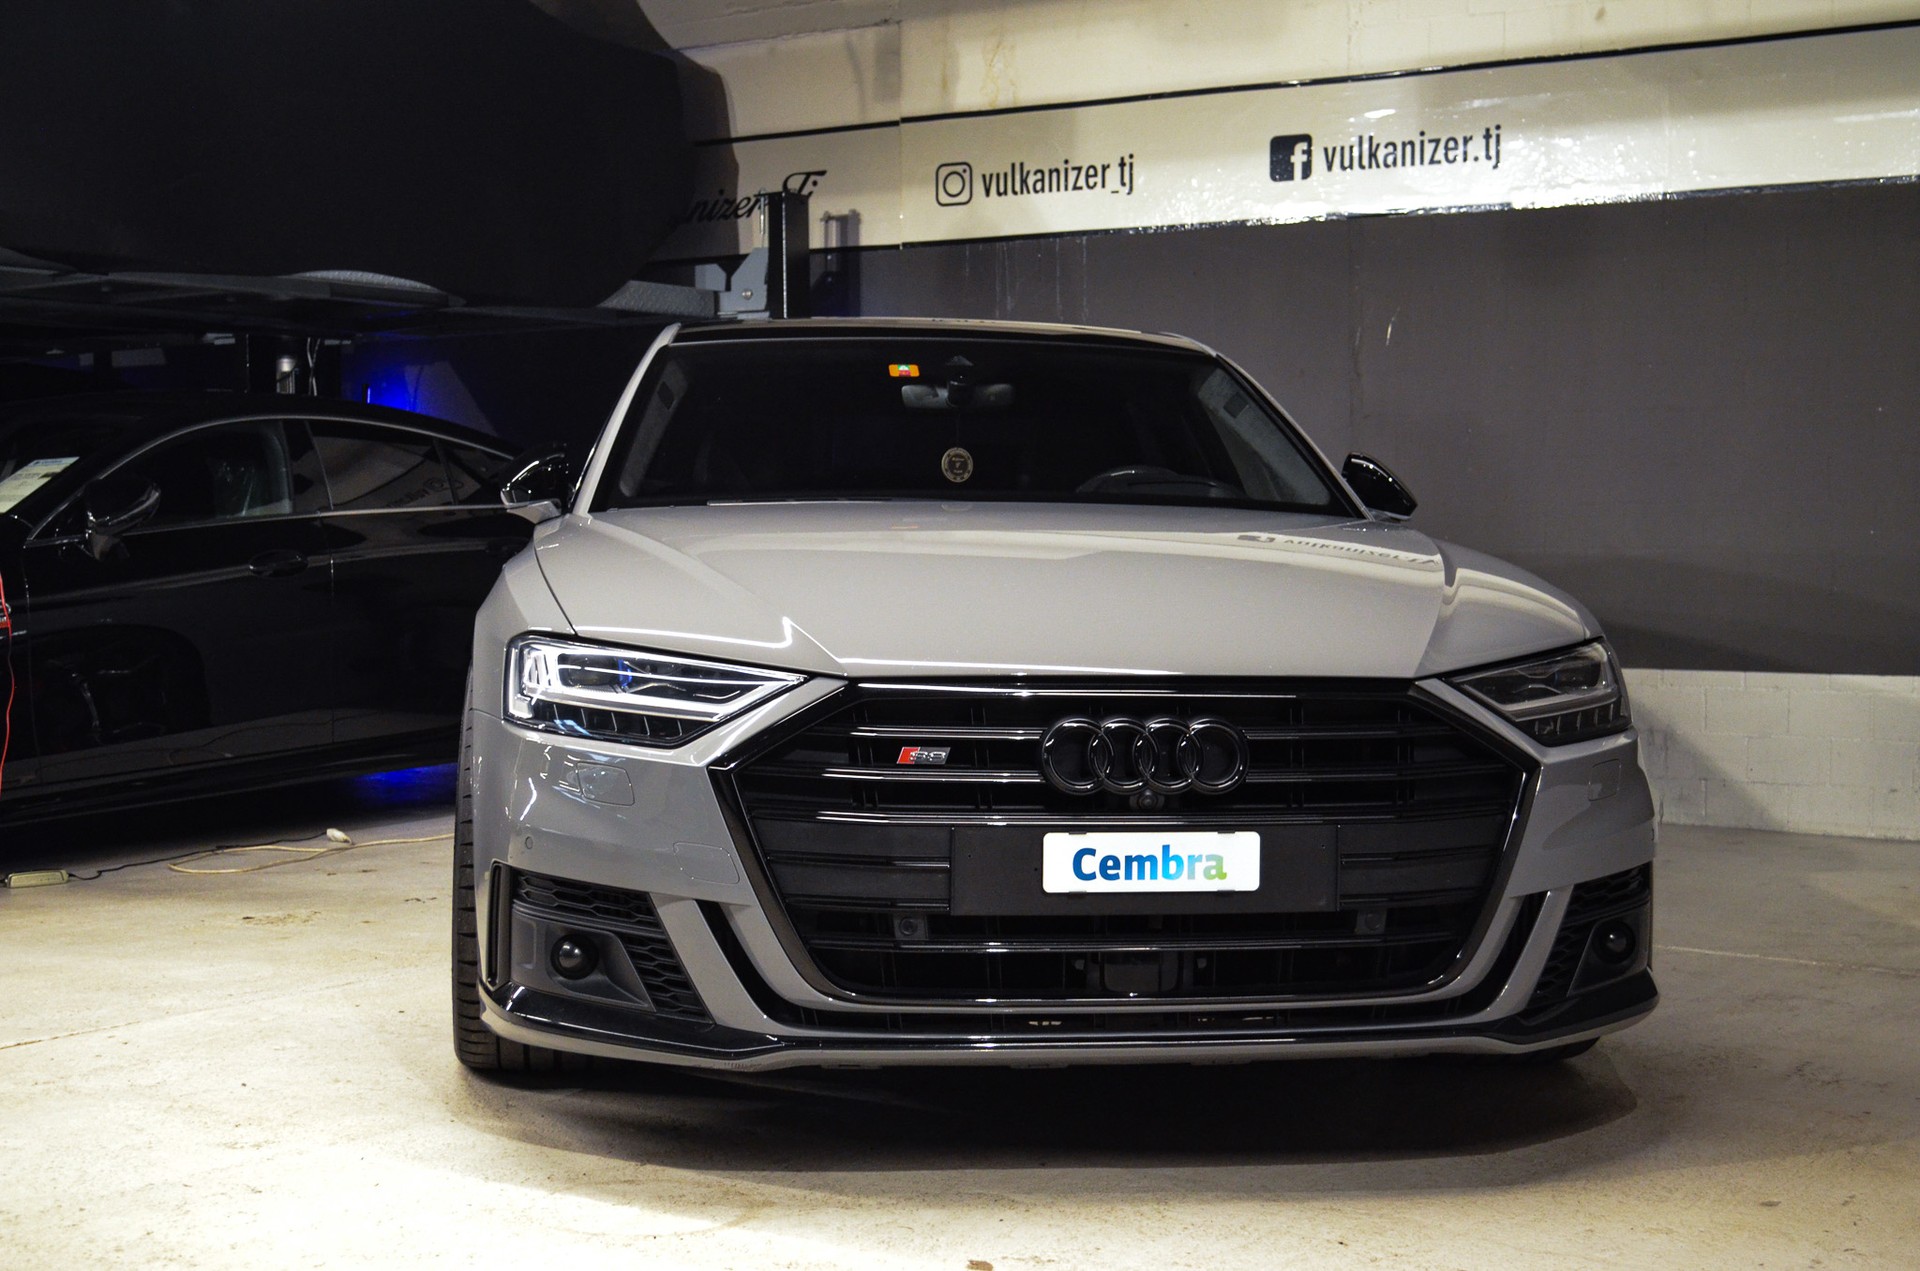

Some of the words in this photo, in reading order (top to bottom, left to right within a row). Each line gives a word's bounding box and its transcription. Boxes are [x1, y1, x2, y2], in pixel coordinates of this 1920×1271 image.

[1323, 124, 1502, 173] vulkanizer.tj
[981, 153, 1134, 196] vulkanizer_tj
[680, 188, 768, 224] nizer
[1072, 844, 1227, 881] Cembra
